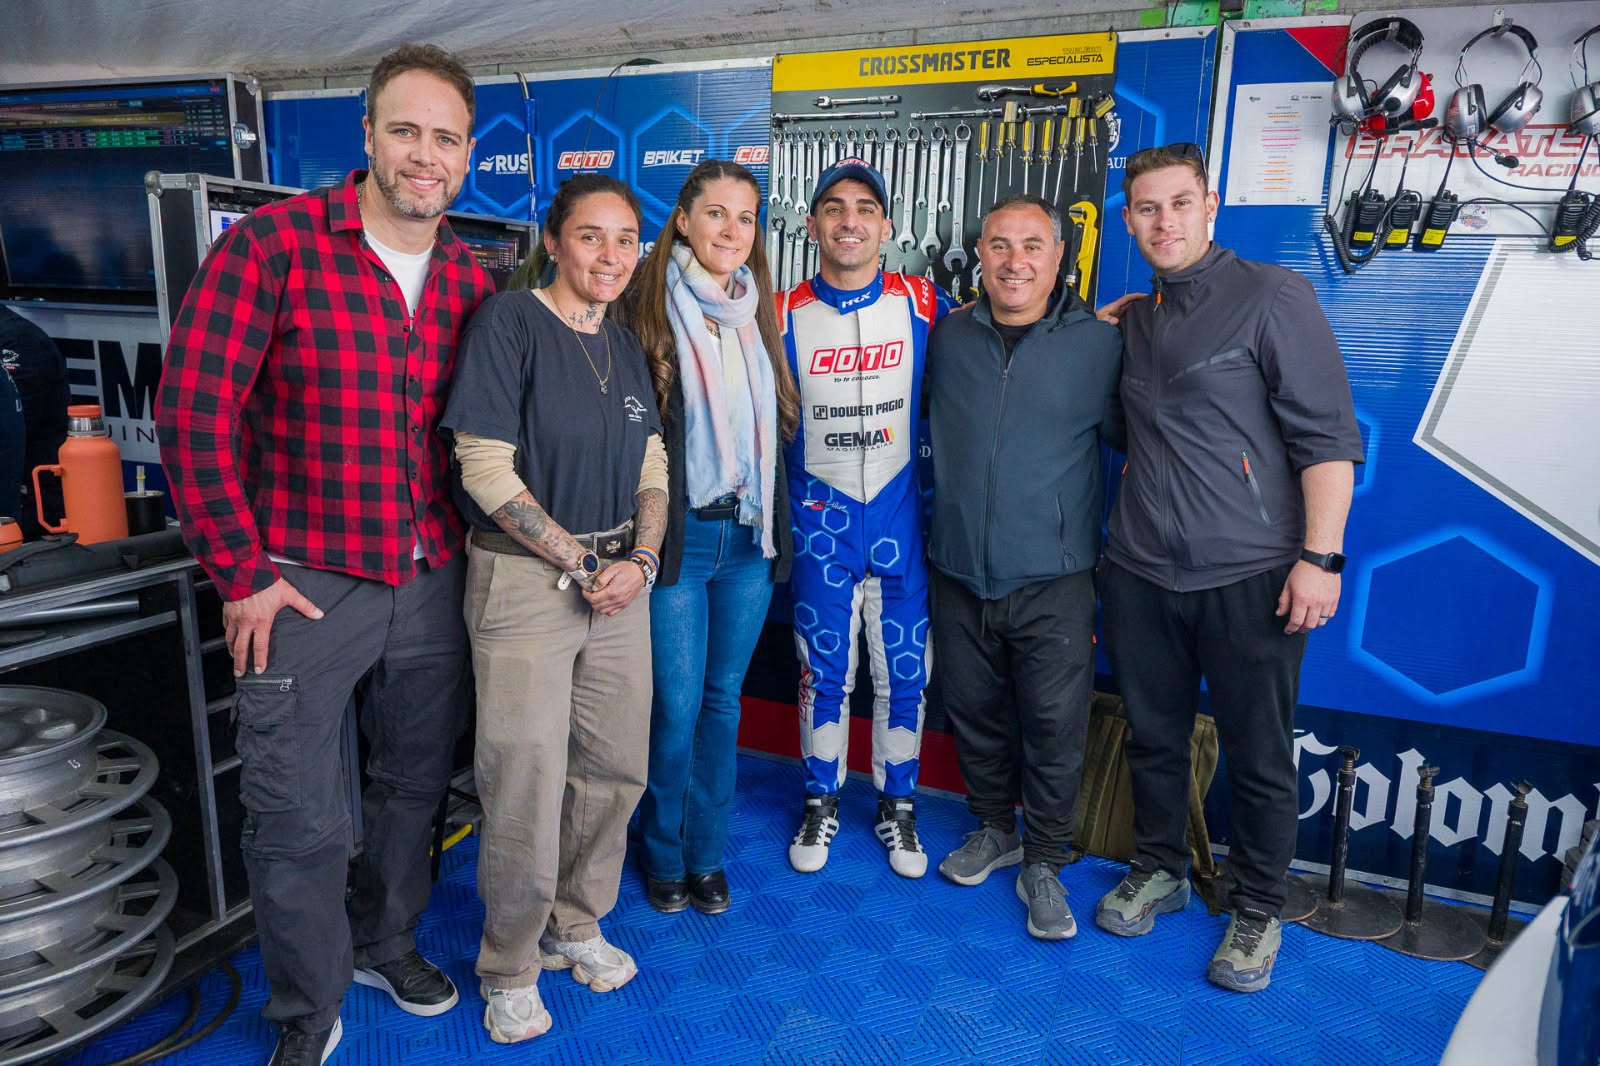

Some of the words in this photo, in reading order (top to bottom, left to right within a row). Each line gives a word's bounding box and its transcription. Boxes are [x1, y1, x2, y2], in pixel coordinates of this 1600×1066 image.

[858, 48, 1011, 77] CROSSMASTER
[1026, 54, 1104, 67] ESPECIALISTA
[495, 154, 530, 172] RUS
[557, 150, 615, 169] COTO
[641, 149, 704, 166] BRIKET
[733, 145, 769, 164] CO
[809, 340, 905, 376] COTO
[830, 405, 873, 418] DOWEN
[824, 429, 885, 447] GEMA
